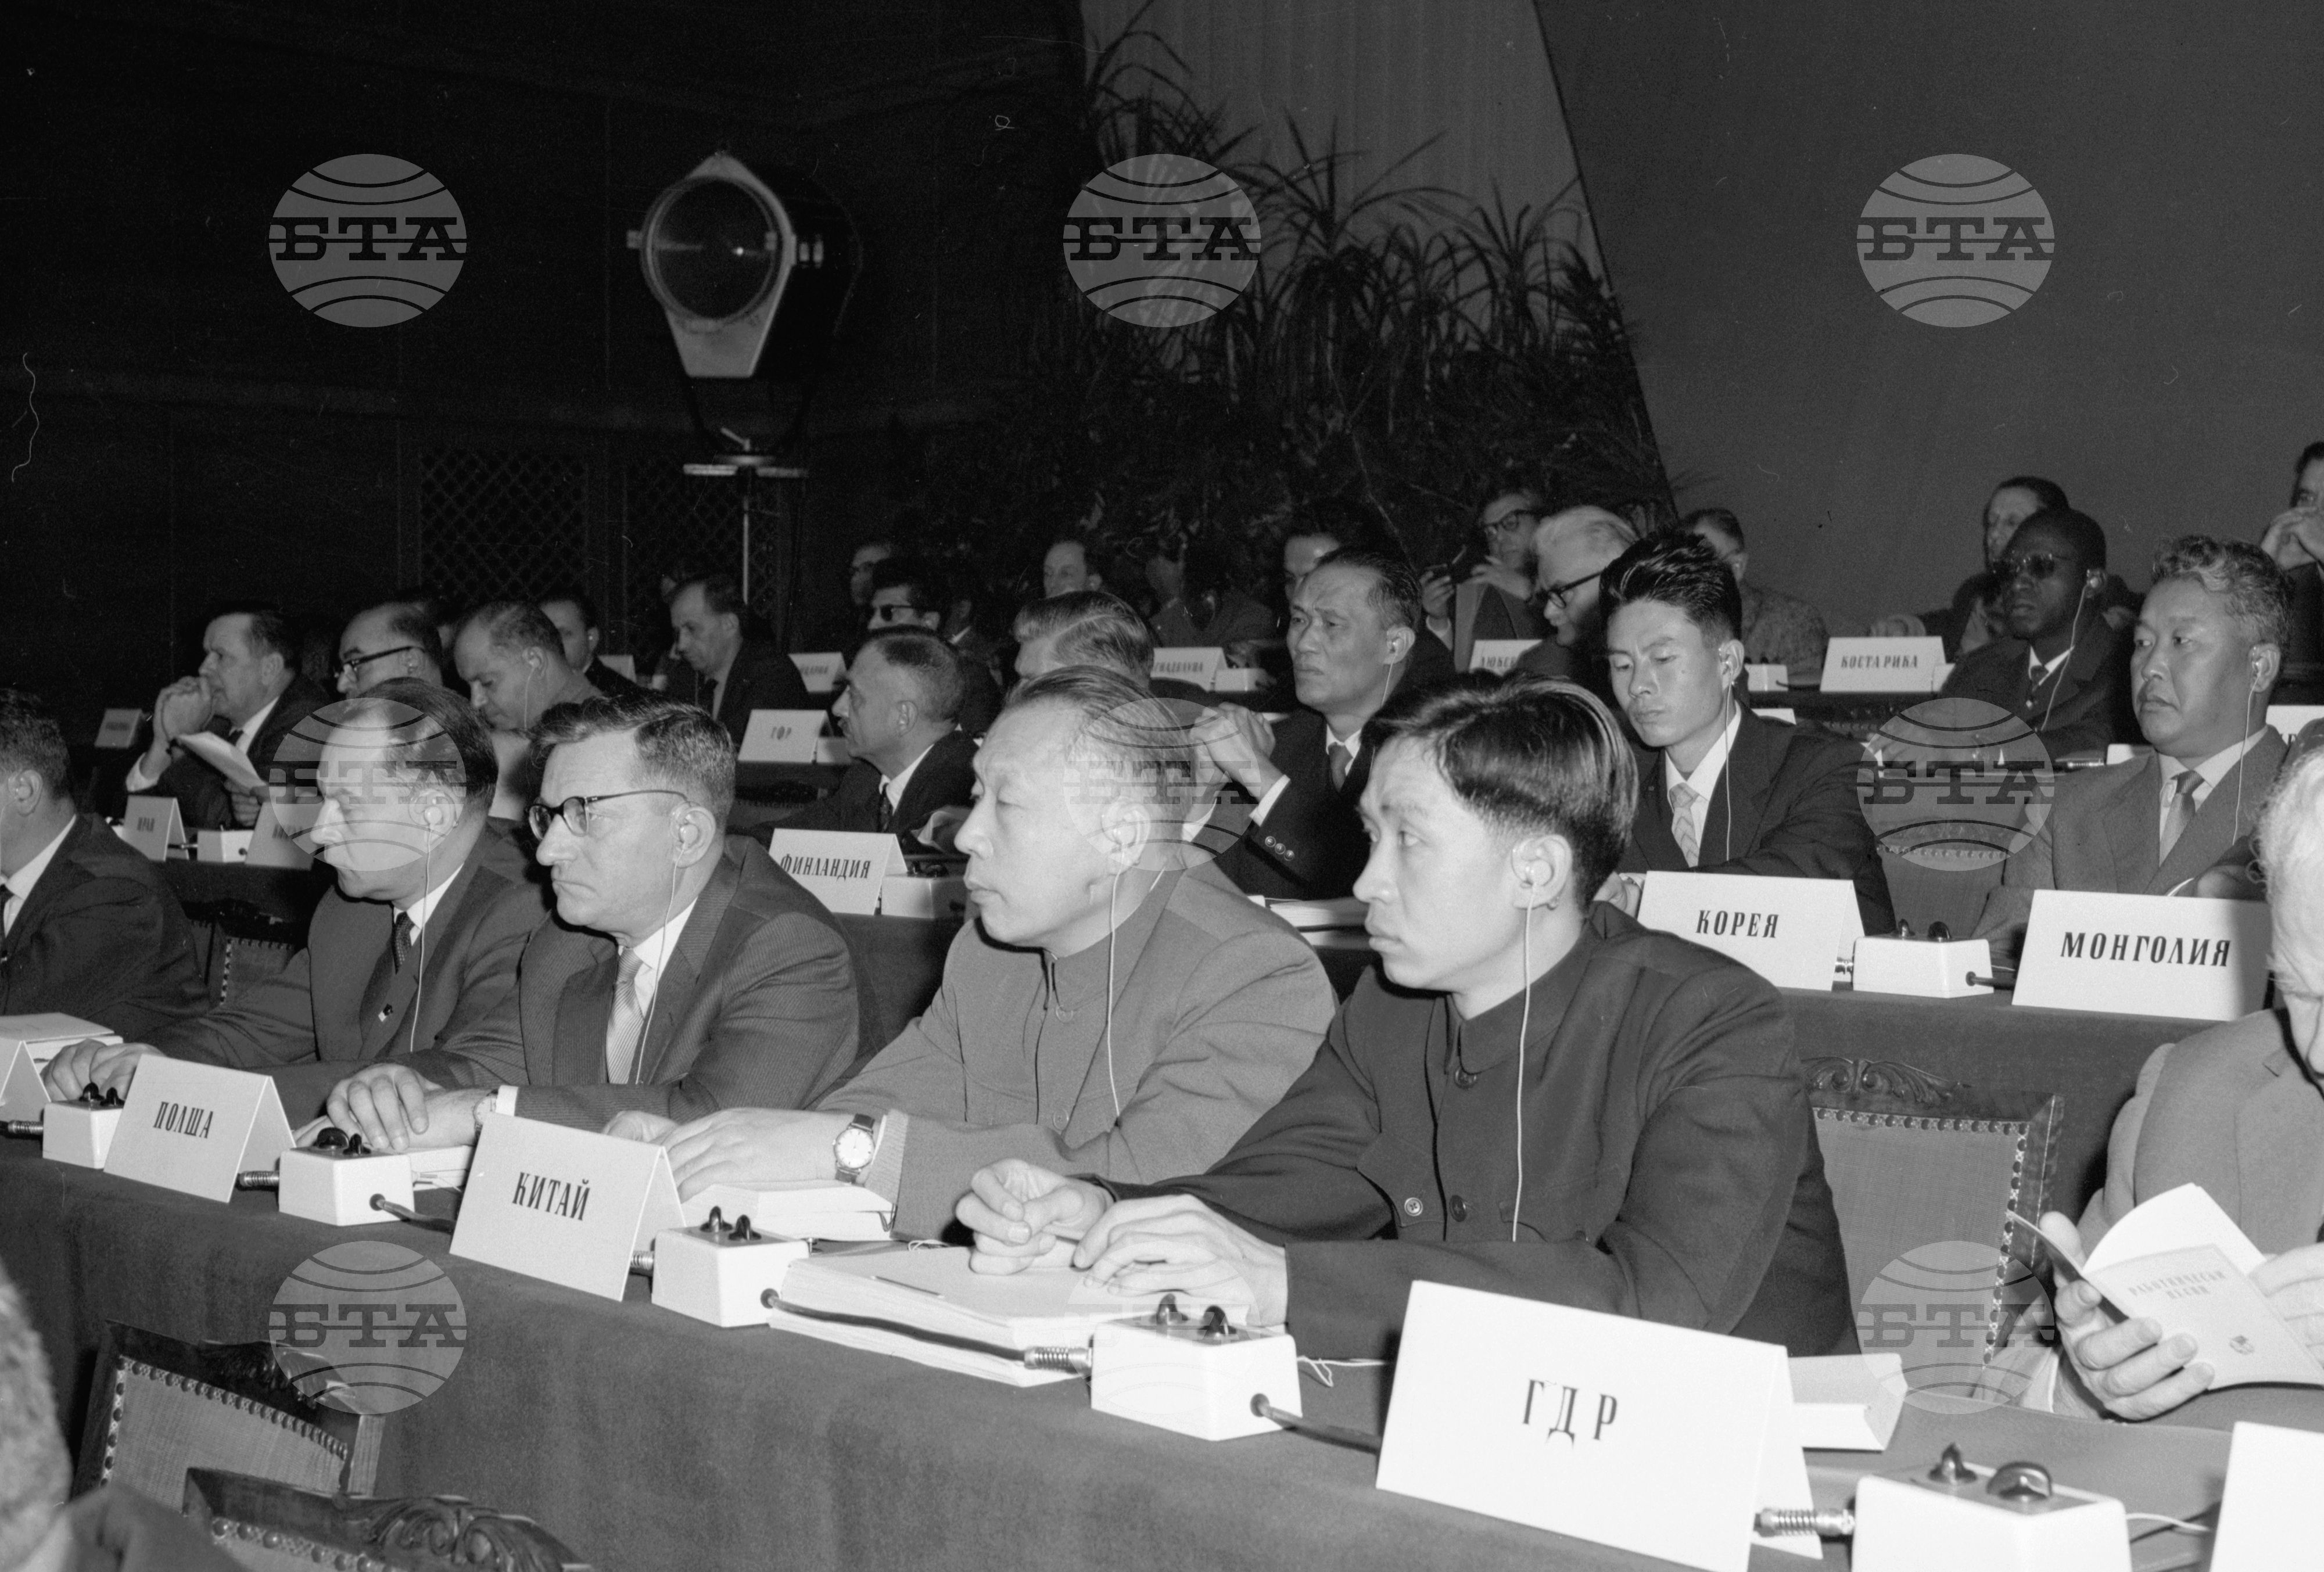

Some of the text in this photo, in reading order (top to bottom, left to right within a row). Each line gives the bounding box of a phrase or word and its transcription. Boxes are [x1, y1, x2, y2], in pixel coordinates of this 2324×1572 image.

[1841, 655, 1917, 668] КОСТА РИКА
[780, 853, 871, 882] ФИНЛАНДИЯ
[1695, 910, 1779, 938] КОРЕЯ
[2060, 932, 2231, 967] МОНГОЛИЯ
[153, 1101, 213, 1139] ПОЛША
[512, 1172, 590, 1221] КИТАЙ
[1522, 1378, 1618, 1449] ГДР
